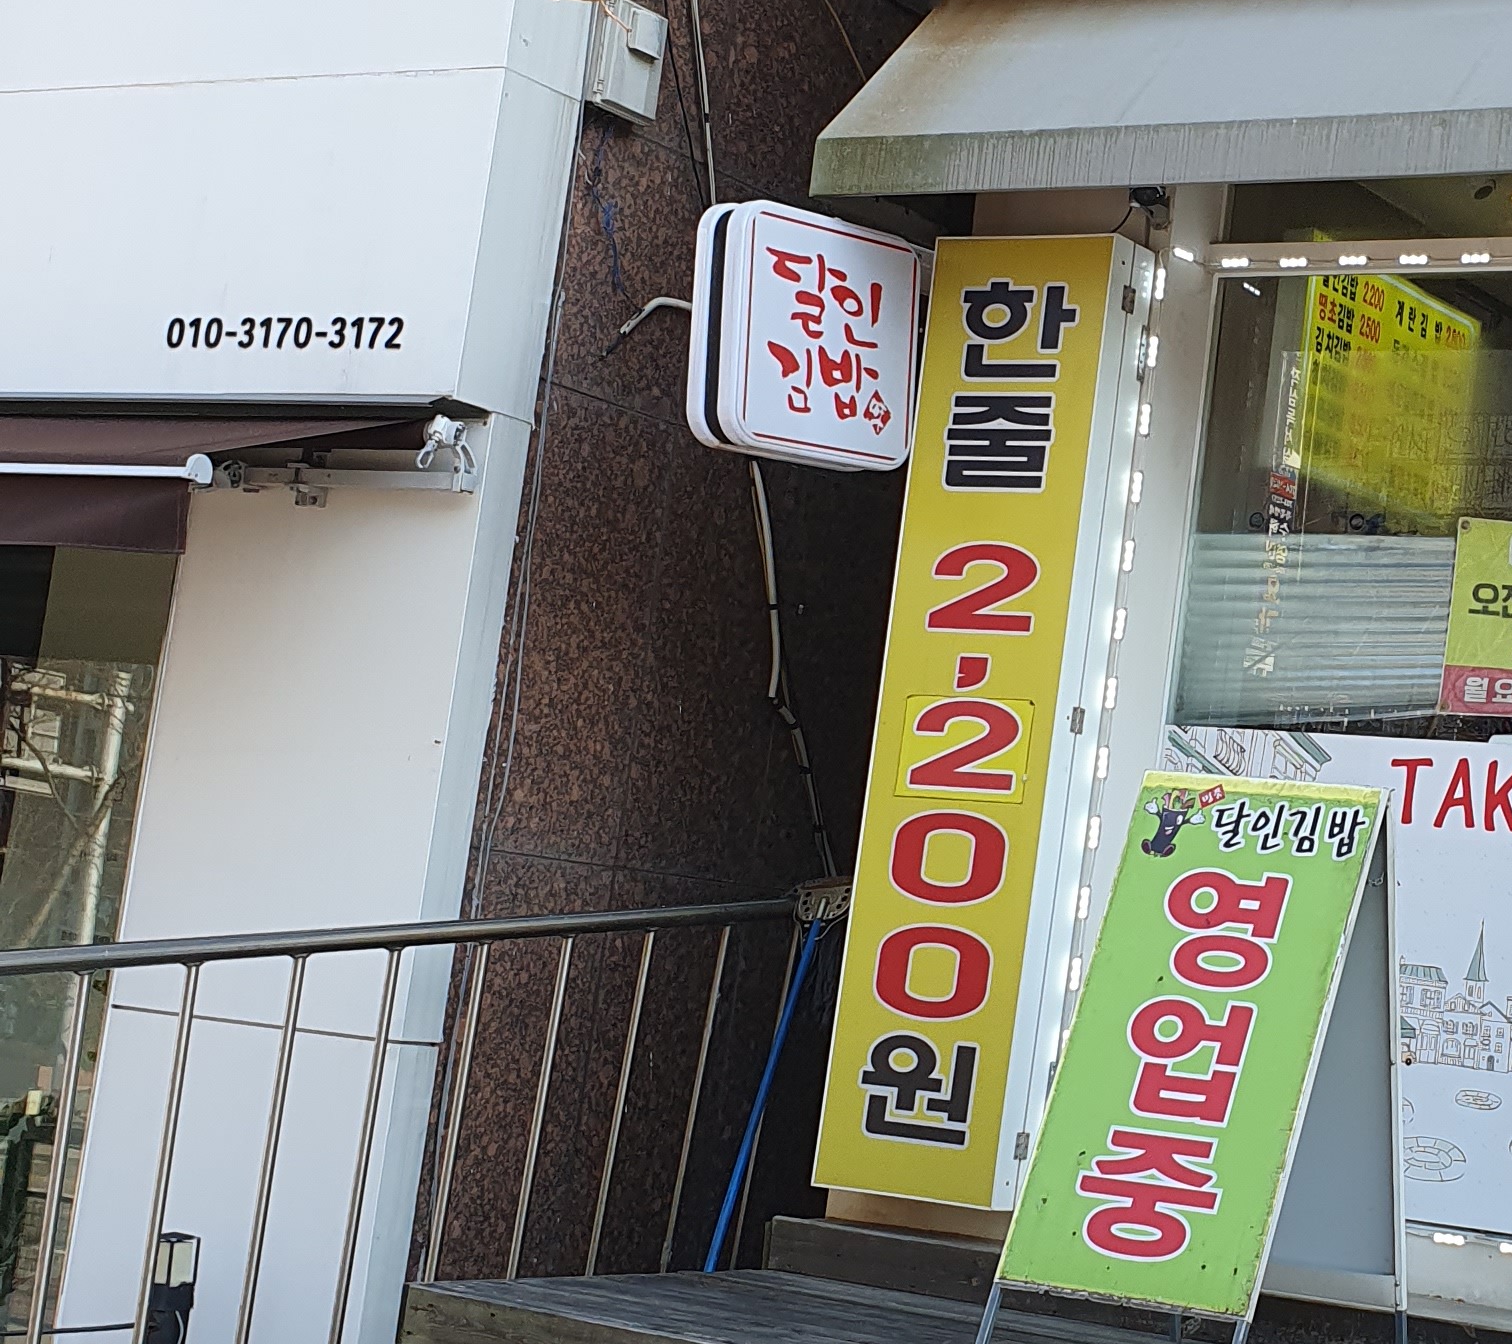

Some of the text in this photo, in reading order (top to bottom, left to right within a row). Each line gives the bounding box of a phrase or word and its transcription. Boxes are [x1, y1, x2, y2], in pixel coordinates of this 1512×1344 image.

[166, 316, 404, 350] 010-3170-3172
[767, 340, 879, 421] 김밥
[942, 277, 1079, 493] 한줄
[1212, 799, 1369, 860] 달인김밥
[1075, 867, 1292, 1262] 영업중
